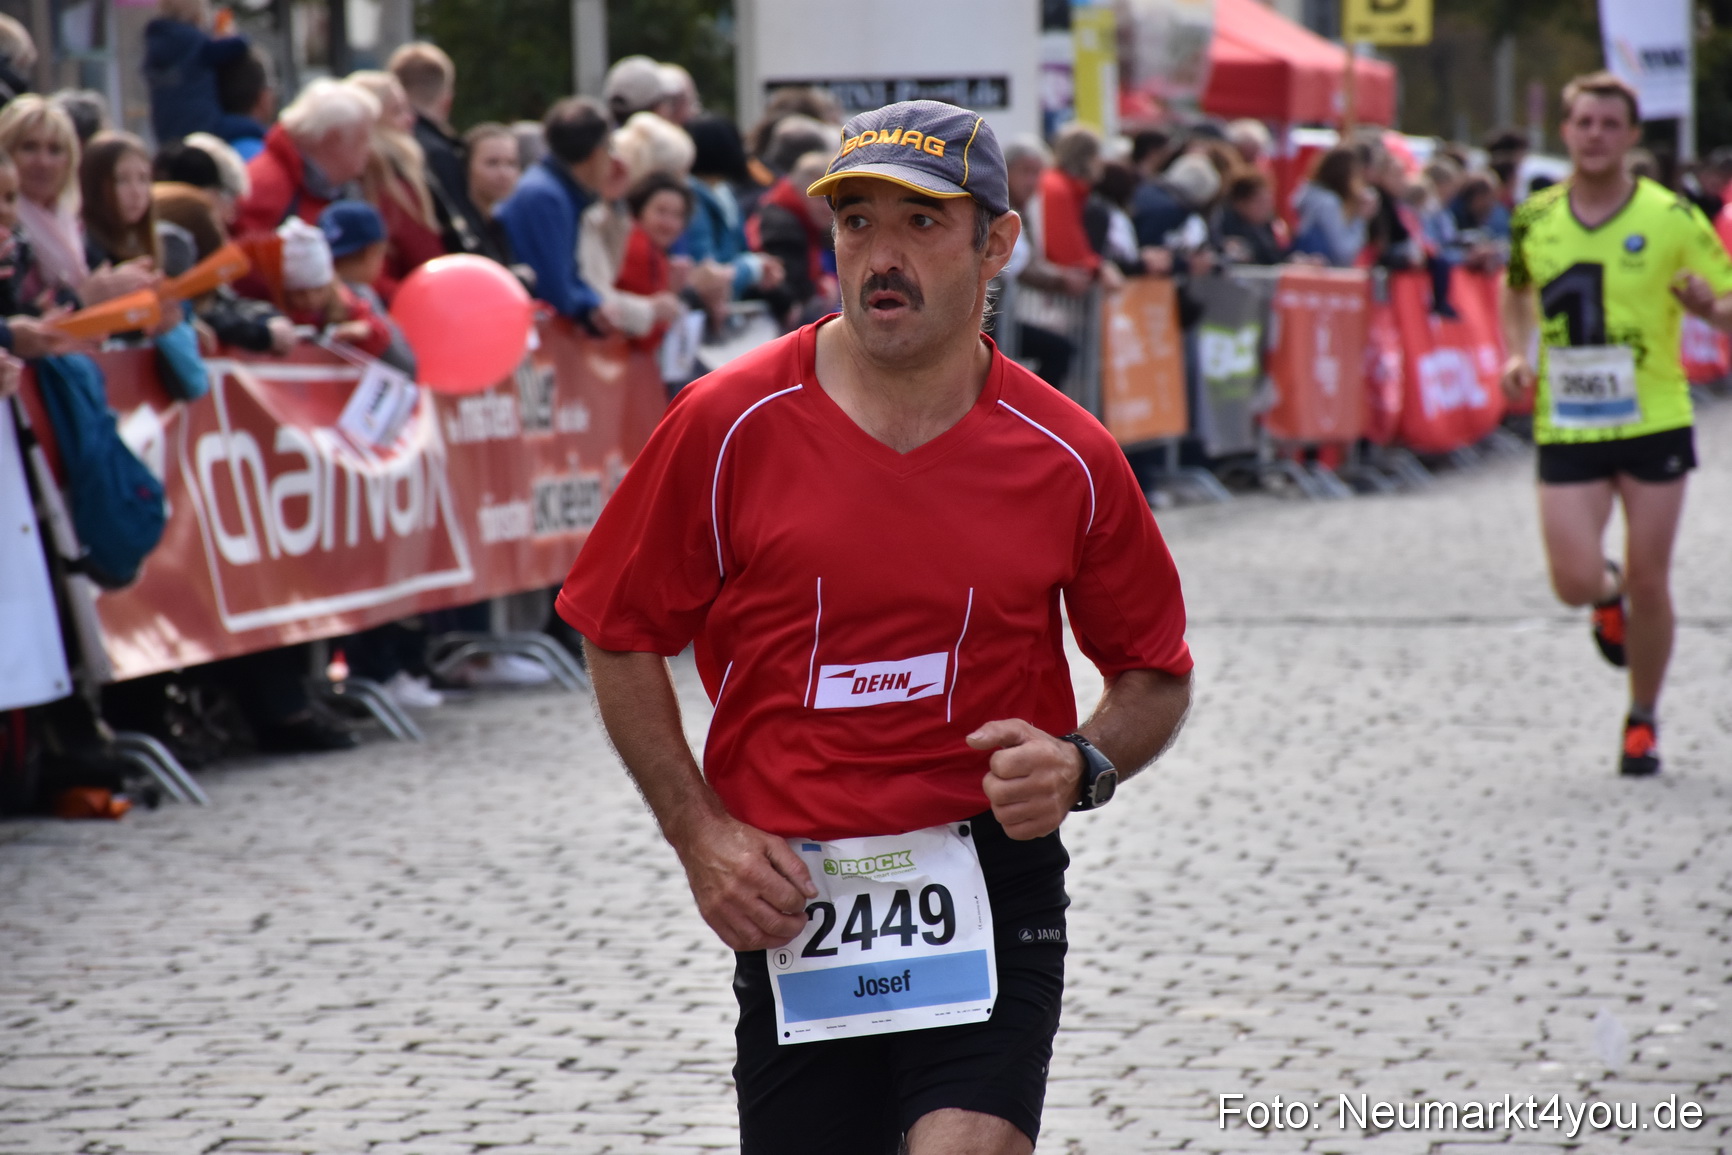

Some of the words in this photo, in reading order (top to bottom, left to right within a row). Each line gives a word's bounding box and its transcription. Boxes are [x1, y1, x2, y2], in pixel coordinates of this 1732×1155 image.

[841, 128, 947, 158] BOMAG
[851, 671, 912, 695] DEHN
[839, 849, 915, 876] BOCK
[801, 883, 957, 958] 2449
[1037, 928, 1061, 941] JAKO
[779, 953, 787, 965] D
[853, 969, 912, 998] Josef
